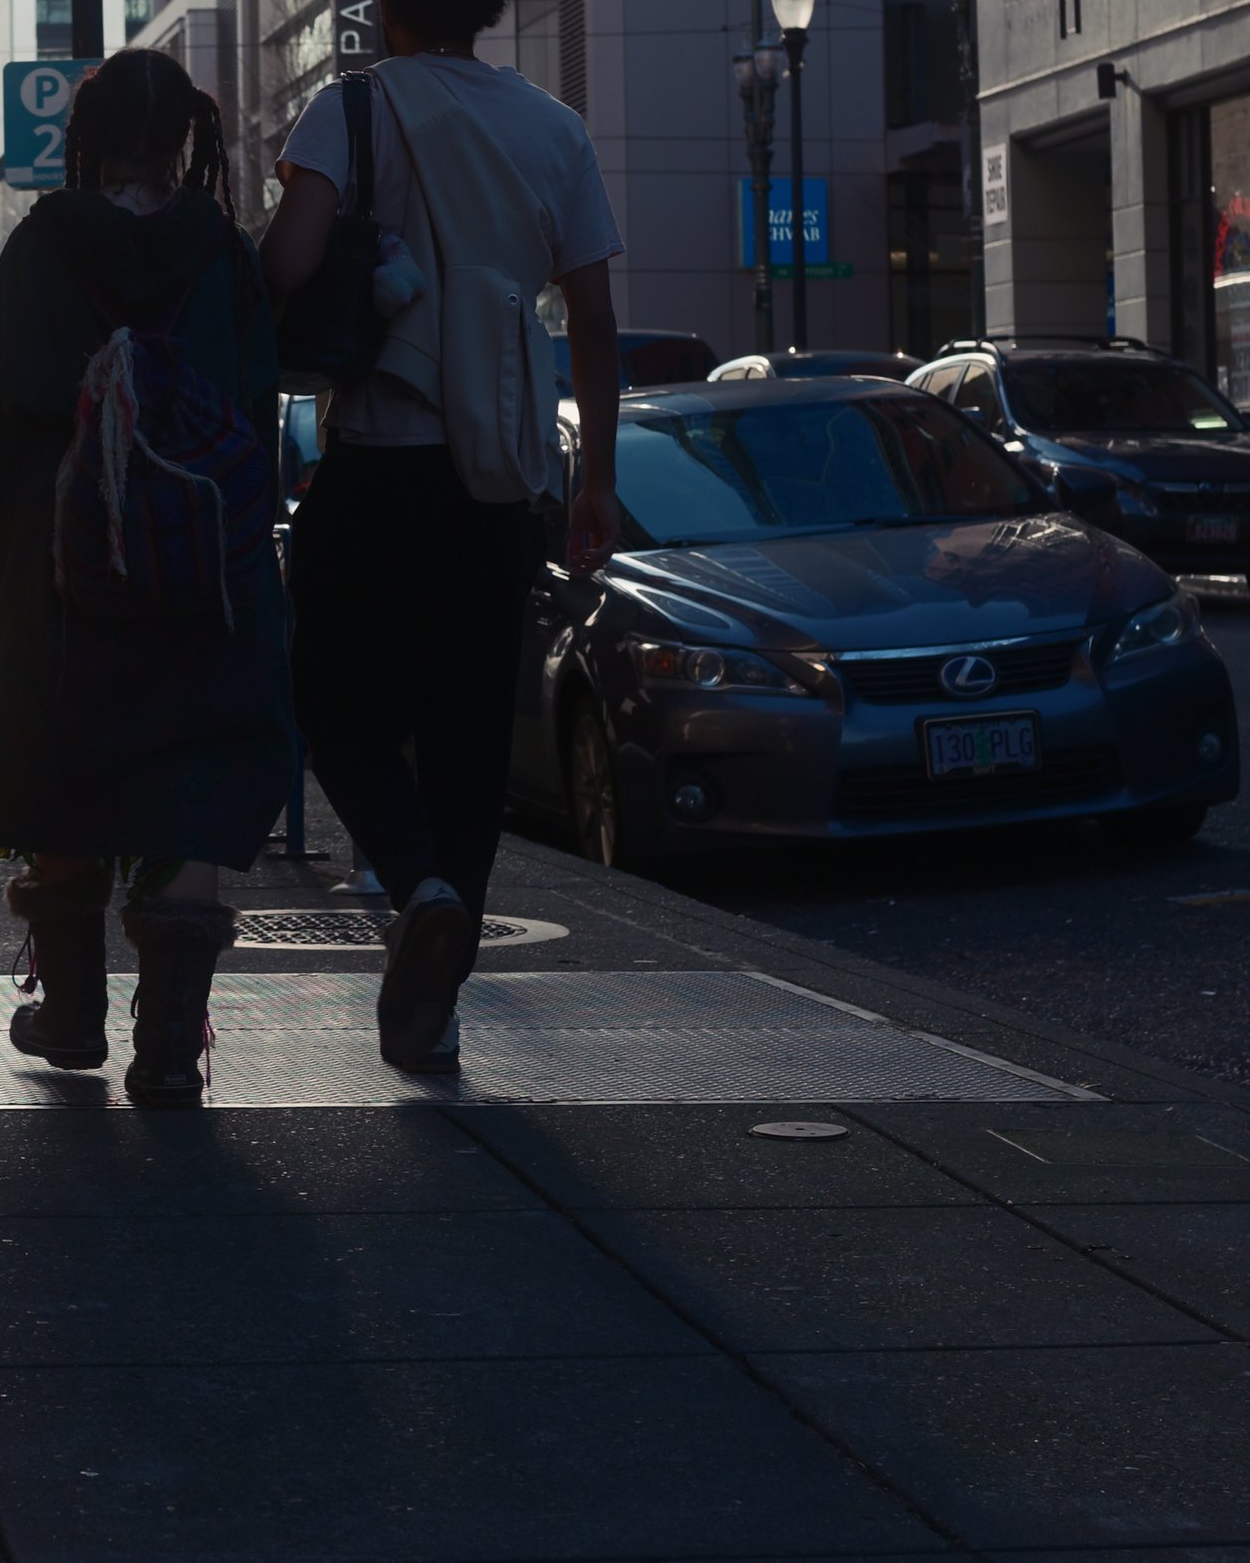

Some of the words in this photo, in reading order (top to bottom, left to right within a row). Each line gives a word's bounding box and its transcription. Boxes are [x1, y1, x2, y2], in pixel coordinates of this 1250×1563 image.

[35, 75, 60, 109] P
[33, 123, 65, 167] 2
[934, 732, 975, 764] 130
[990, 726, 1033, 759] PLG
